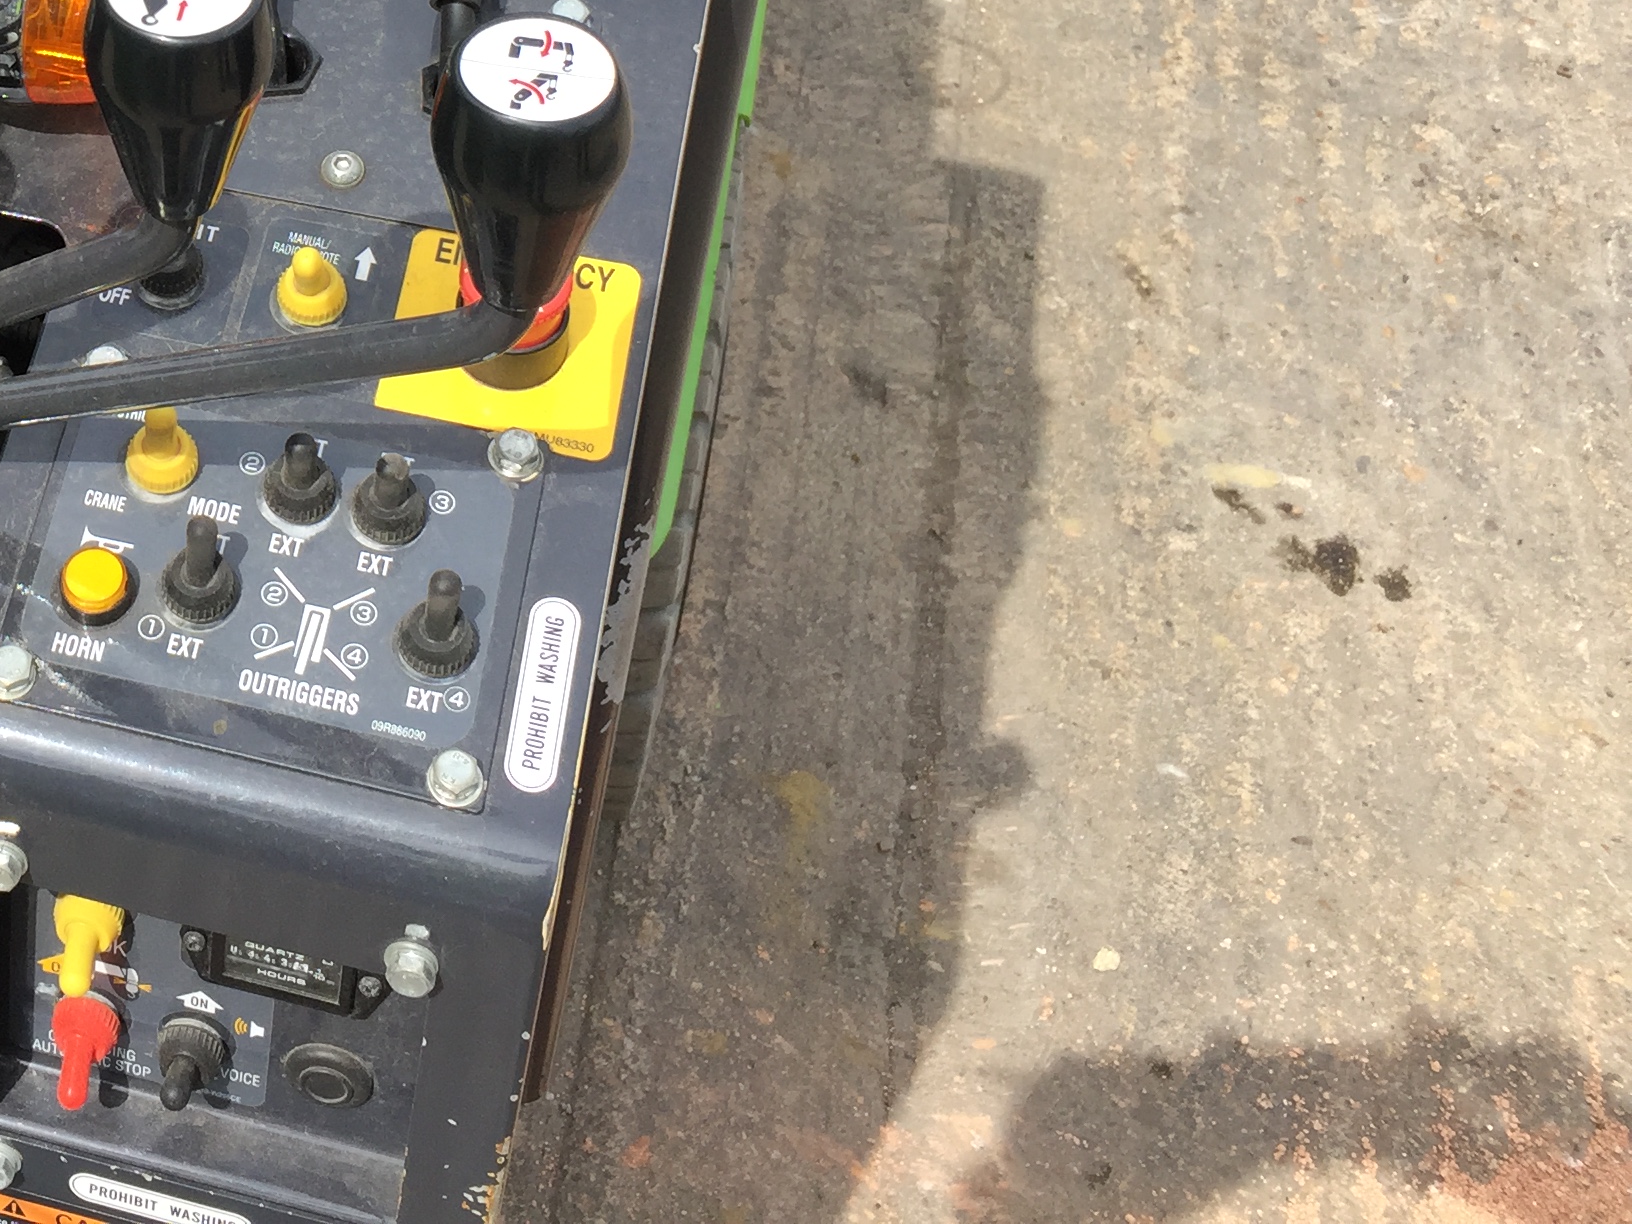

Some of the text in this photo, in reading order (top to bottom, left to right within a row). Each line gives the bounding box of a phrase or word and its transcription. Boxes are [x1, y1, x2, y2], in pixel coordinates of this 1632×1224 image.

[99, 287, 131, 305] OFF
[84, 490, 127, 512] CRANE
[187, 497, 242, 524] MODE
[268, 533, 304, 557] EXT
[357, 552, 393, 575] EXT
[52, 632, 106, 661] HORN
[167, 635, 204, 659] EXT
[238, 668, 359, 715] OUTRIGGERS
[406, 687, 442, 713] EXT
[522, 615, 564, 770] PROHIBIT WASHING
[245, 941, 305, 961] QUARTZ
[257, 968, 307, 985] HOURS
[190, 996, 209, 1009] ON
[115, 1061, 152, 1077] STOP
[220, 1067, 261, 1087] VOICE
[89, 1183, 158, 1211] PROHIBIT
